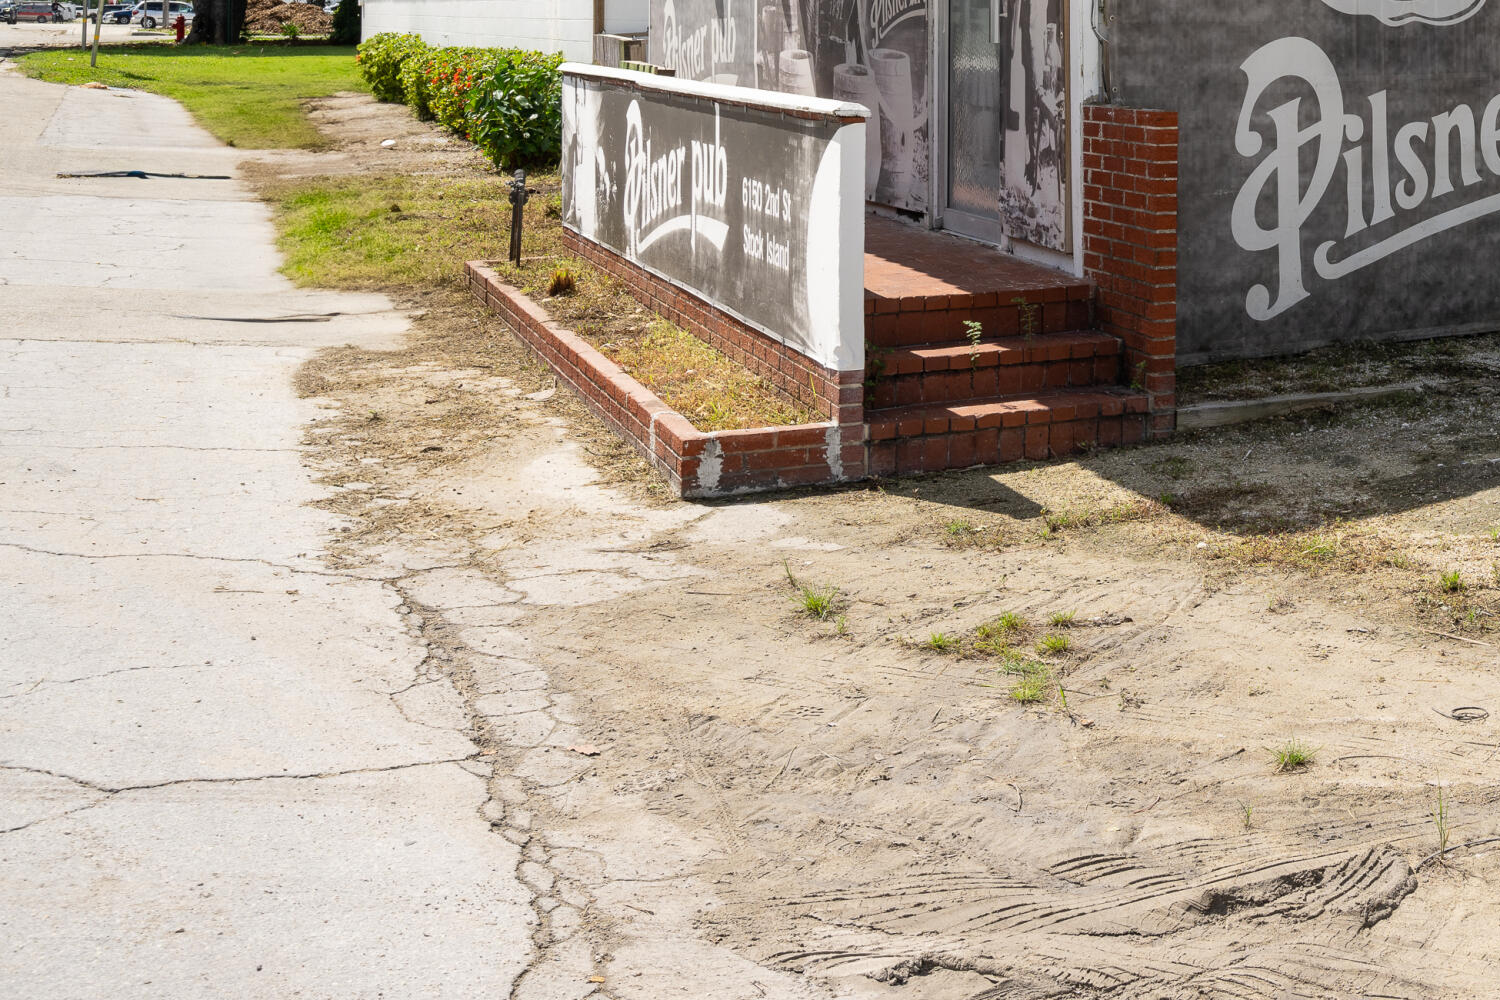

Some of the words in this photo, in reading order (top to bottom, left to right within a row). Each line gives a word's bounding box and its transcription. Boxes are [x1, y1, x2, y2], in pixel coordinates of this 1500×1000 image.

[624, 99, 686, 260] Pilsner
[691, 102, 728, 254] pub
[742, 176, 763, 212] 6150
[764, 183, 780, 218] 2nd
[782, 189, 792, 223] St
[743, 224, 764, 260] Stock
[766, 231, 790, 271] Island
